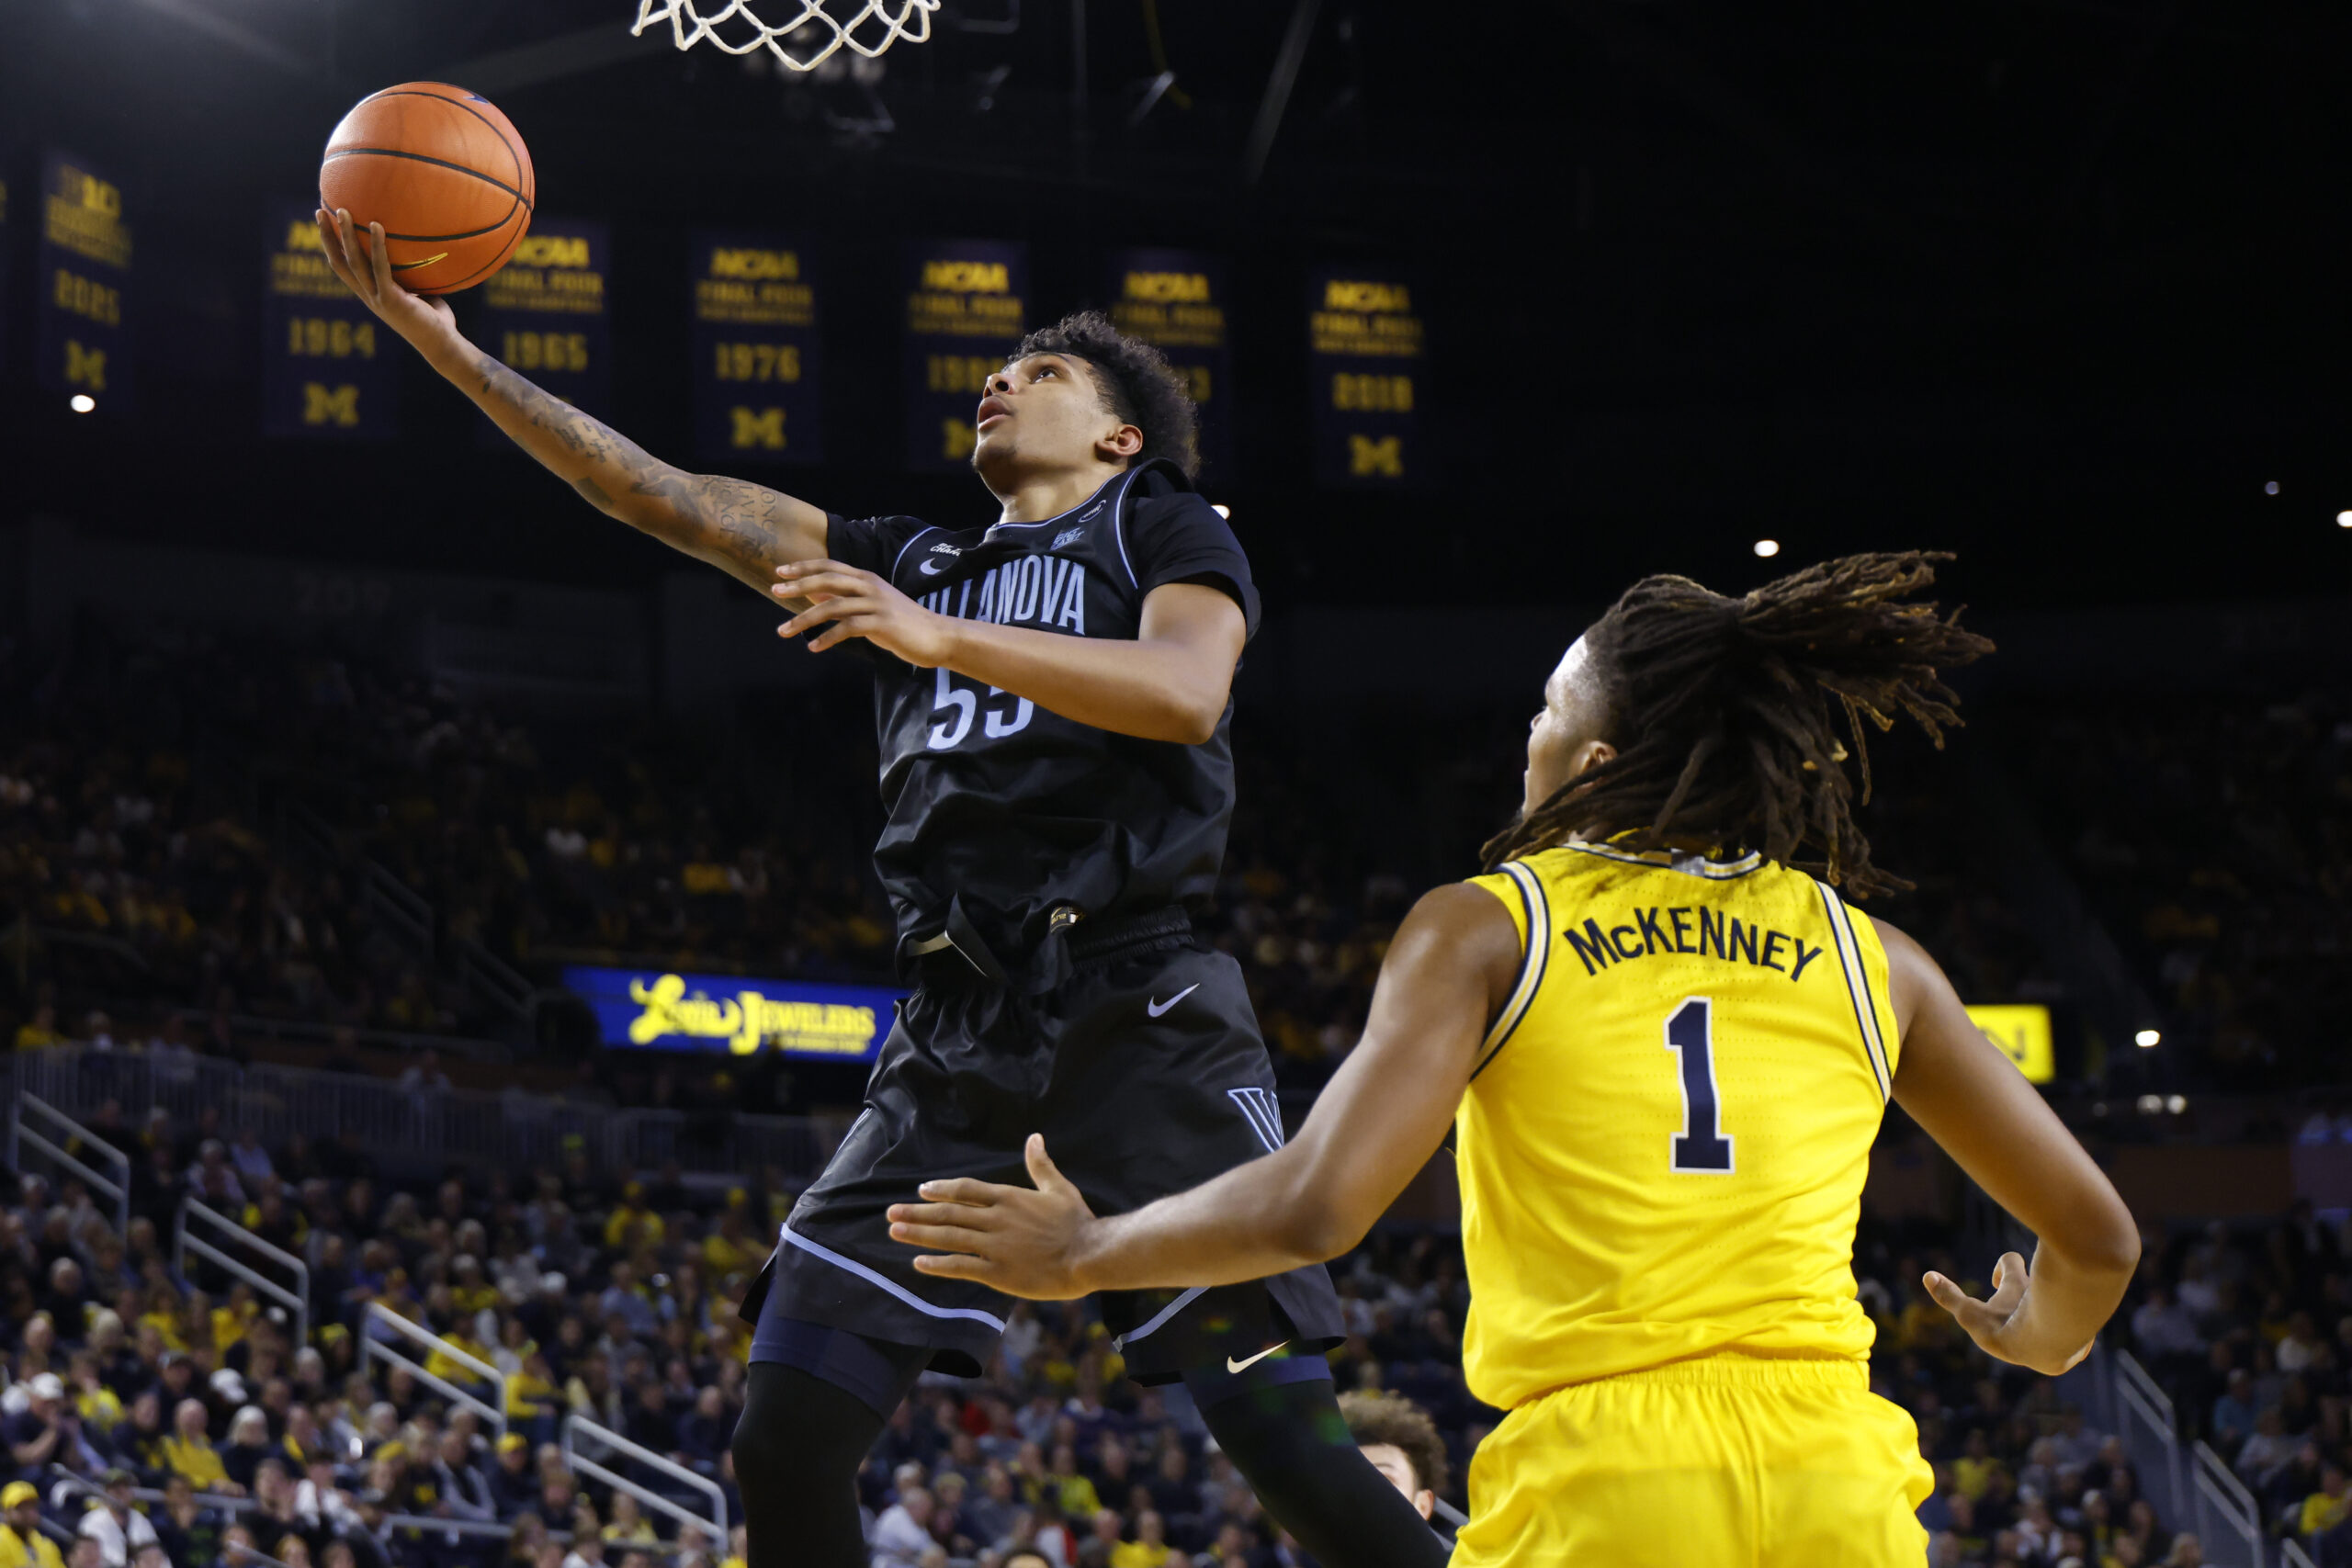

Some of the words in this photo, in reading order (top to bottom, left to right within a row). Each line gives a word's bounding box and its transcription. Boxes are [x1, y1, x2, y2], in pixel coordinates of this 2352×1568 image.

[709, 246, 798, 280] NCAA
[922, 261, 1009, 293] NCAA
[1123, 271, 1210, 303] NCAA
[1324, 279, 1411, 313] NCAA
[288, 318, 376, 359] 1964
[503, 332, 588, 372] 1965
[715, 343, 801, 384] 1976
[1563, 905, 1823, 982] McKENNEY
[1663, 995, 1735, 1174] 1
